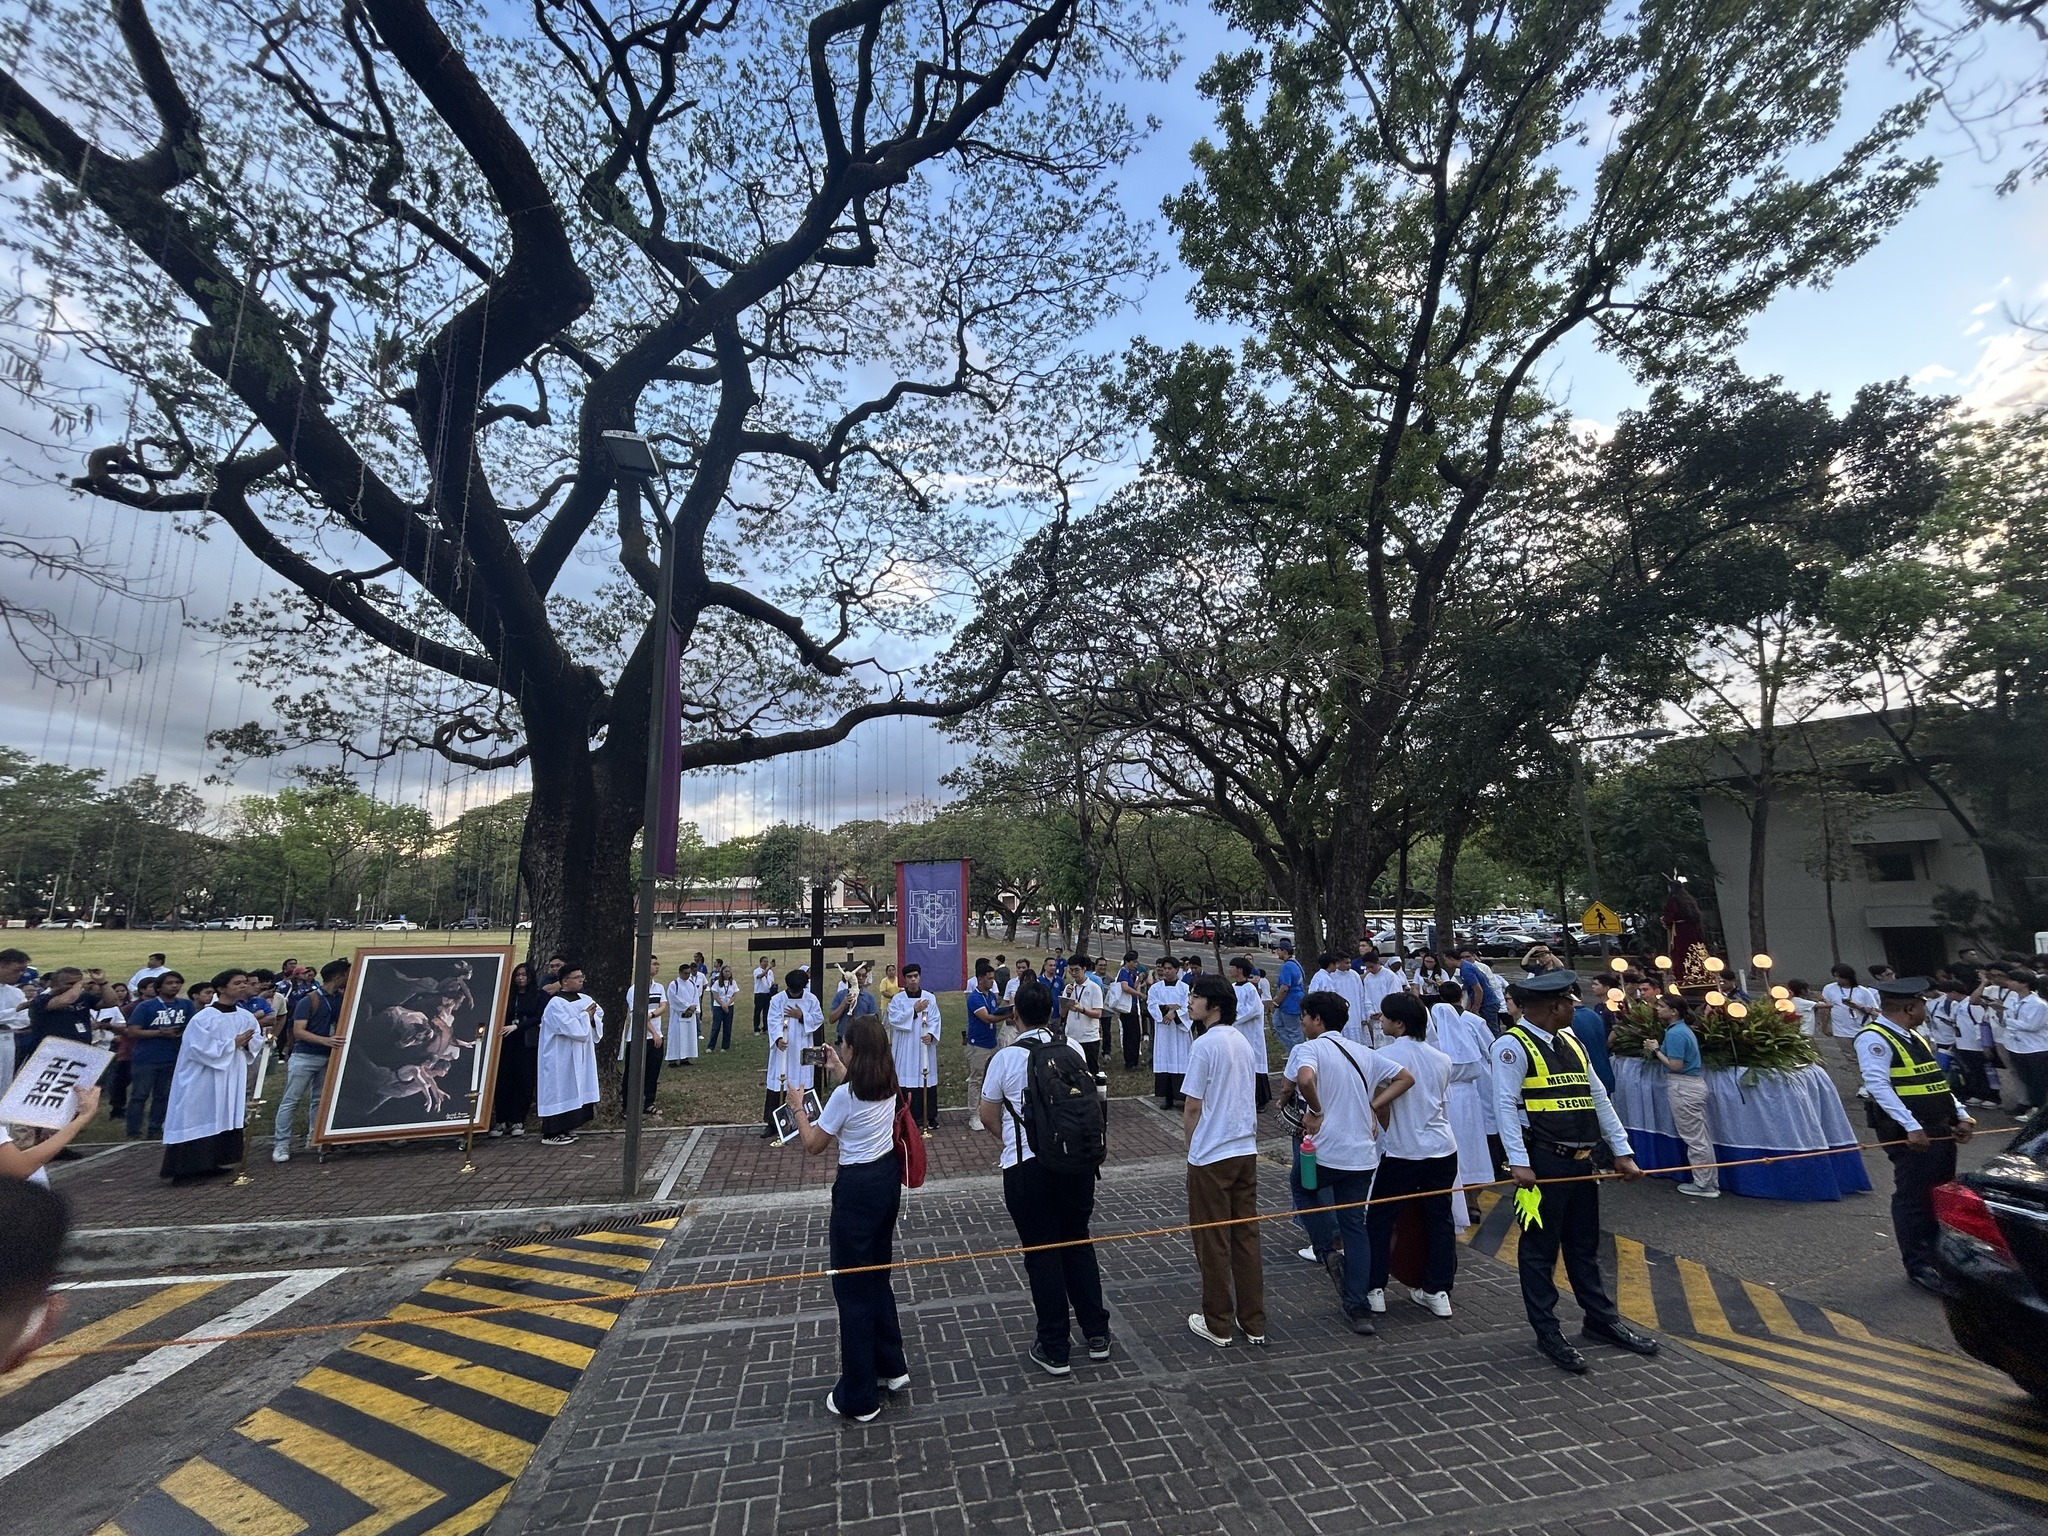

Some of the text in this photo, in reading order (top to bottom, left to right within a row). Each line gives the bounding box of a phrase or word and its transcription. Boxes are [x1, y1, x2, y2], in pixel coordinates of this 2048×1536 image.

[813, 938, 822, 946] IX
[23, 1056, 69, 1106] HERE
[42, 1060, 88, 1109] LINE
